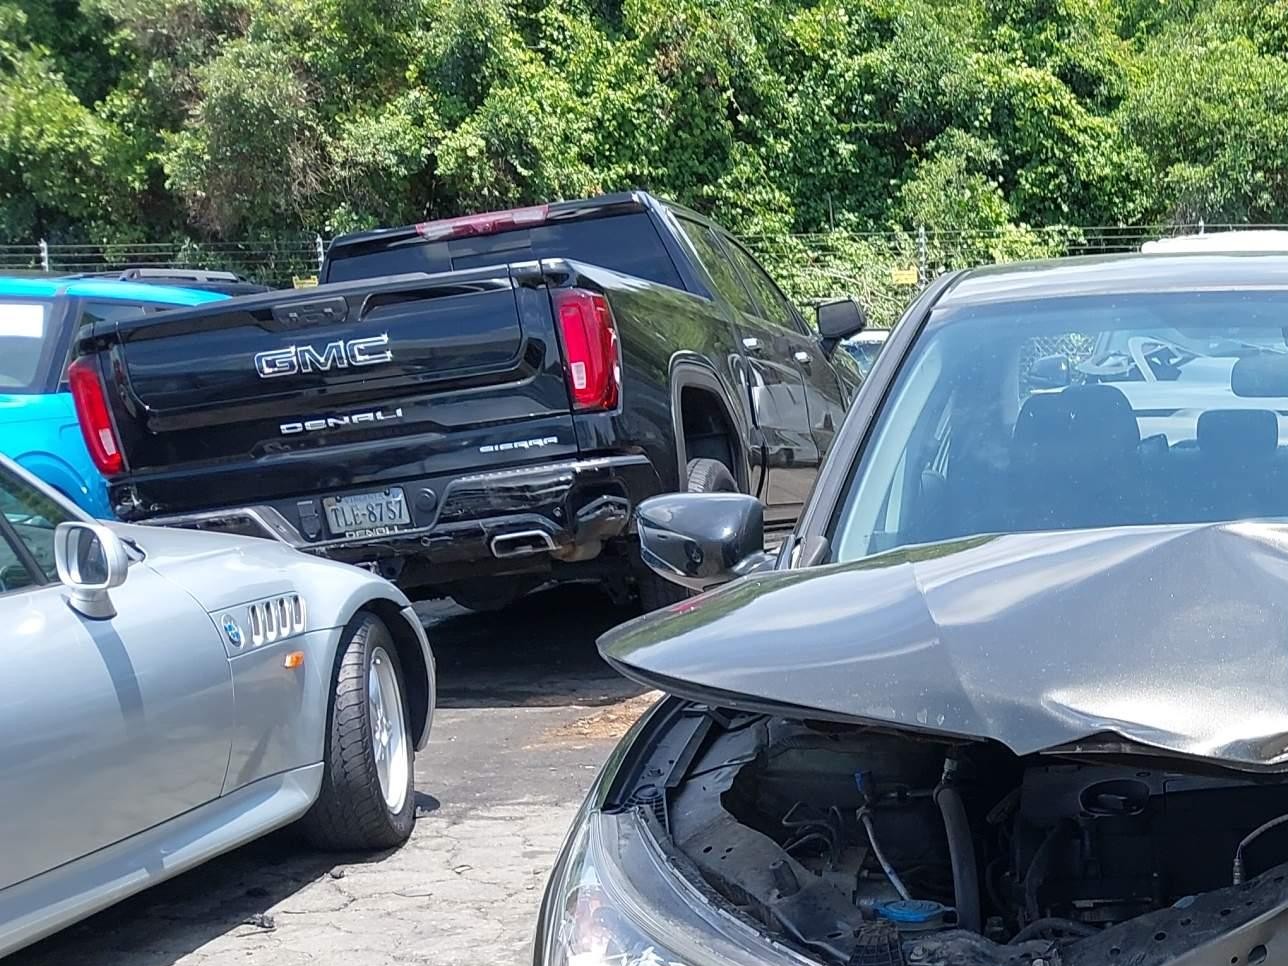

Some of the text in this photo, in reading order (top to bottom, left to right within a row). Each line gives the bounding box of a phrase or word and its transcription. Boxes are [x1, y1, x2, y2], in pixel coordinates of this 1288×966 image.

[254, 332, 393, 379] GMC
[280, 407, 403, 435] DENALI
[479, 436, 558, 453] SIERRA
